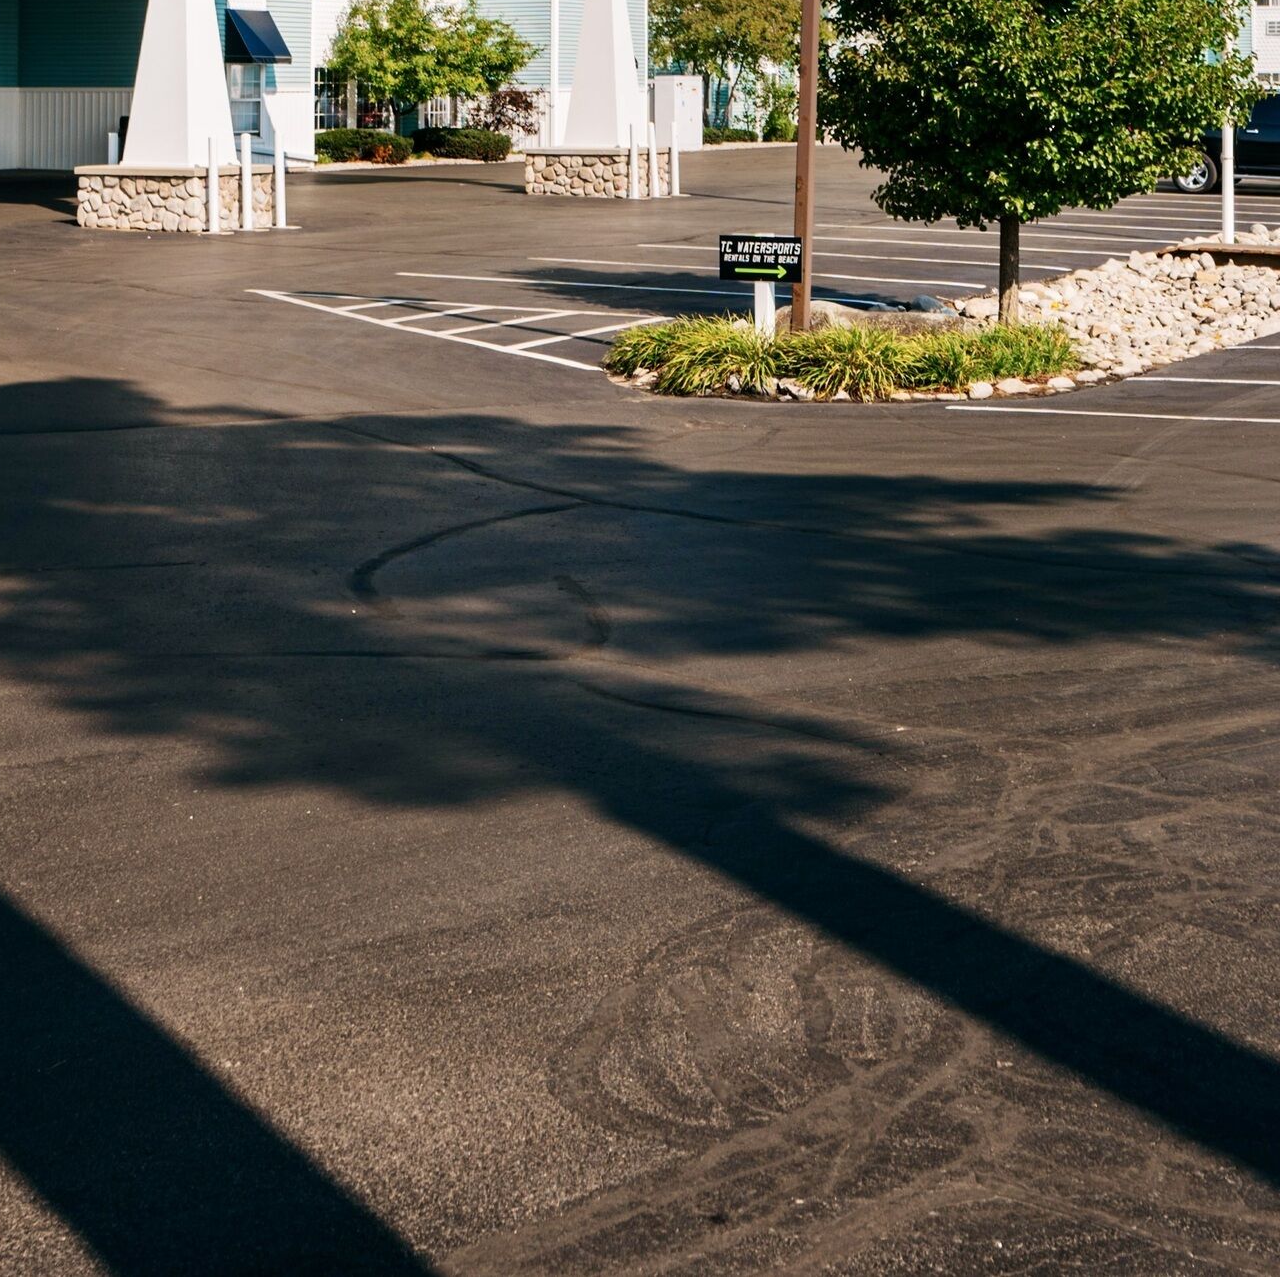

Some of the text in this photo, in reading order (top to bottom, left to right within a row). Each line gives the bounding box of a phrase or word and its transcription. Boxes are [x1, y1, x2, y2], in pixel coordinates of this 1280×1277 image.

[721, 241, 801, 255] TC WATERSPORTS
[724, 254, 798, 264] RENTALS ON THE BEACH
